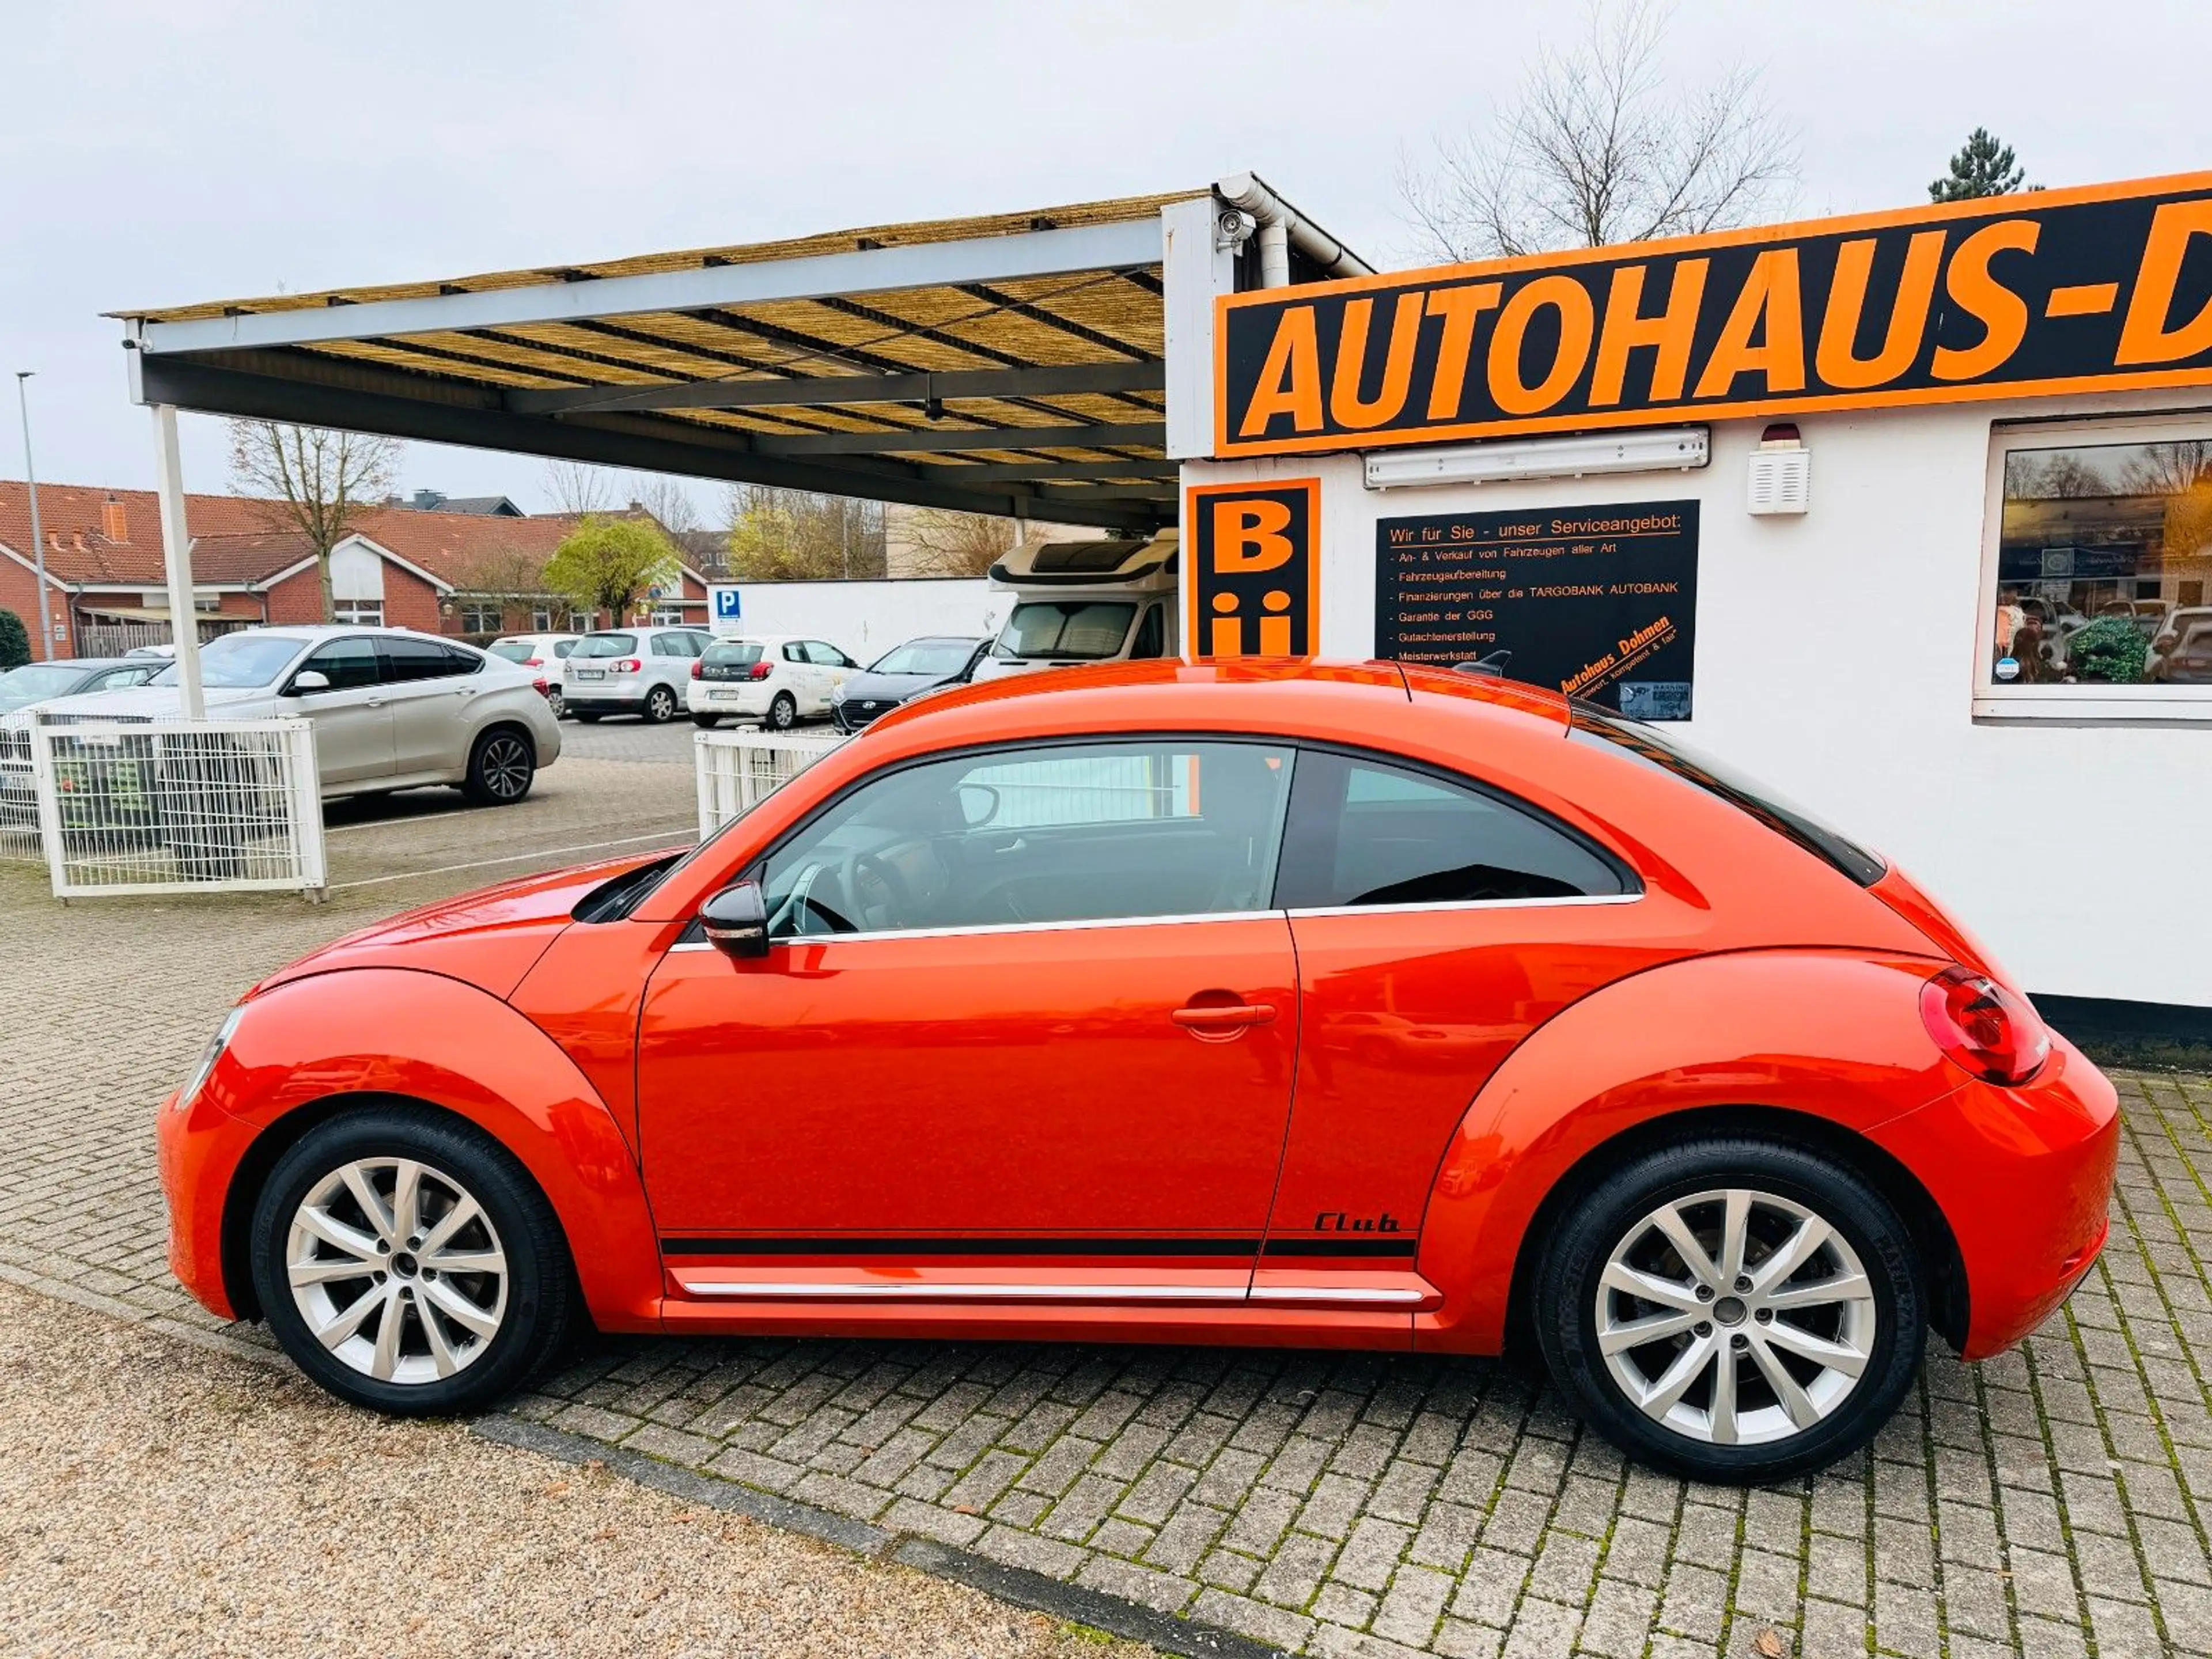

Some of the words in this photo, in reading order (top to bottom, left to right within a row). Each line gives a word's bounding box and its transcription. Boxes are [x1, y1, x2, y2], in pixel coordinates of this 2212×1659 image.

[1390, 528, 1414, 542] Wir
[1422, 527, 1441, 541] für
[1450, 525, 1474, 539] Sie
[1499, 524, 1541, 537] unser
[1551, 514, 1680, 533] Serviceangebot:
[1399, 552, 1416, 562] An-
[1421, 551, 1429, 562] &
[1434, 550, 1473, 561] Verkauf
[1479, 550, 1497, 558] von
[1503, 547, 1565, 558] Fahrzeugen
[1571, 544, 1594, 554] aller
[1600, 543, 1616, 553] Art
[1399, 569, 1506, 582] Fahrzeugaufbereitung
[1399, 591, 1473, 602] Finanzierungen
[1479, 589, 1502, 599] über
[1508, 589, 1524, 599] die
[1529, 585, 1603, 597] TARGOBANK
[1610, 582, 1678, 594] AUTOBANK
[721, 591, 735, 614] P
[1399, 612, 1440, 622] Garantie
[1445, 612, 1461, 621] der
[1467, 609, 1494, 620] GGG
[1399, 632, 1495, 642] Gutachtenerstellung
[1399, 651, 1477, 661] Meisterwerkstatt
[1560, 653, 1615, 695] Autohaus
[1618, 616, 1670, 655] Dohmen
[1609, 649, 1650, 679] kompetent
[1652, 642, 1660, 651] &
[1315, 1212, 1400, 1232] Club
